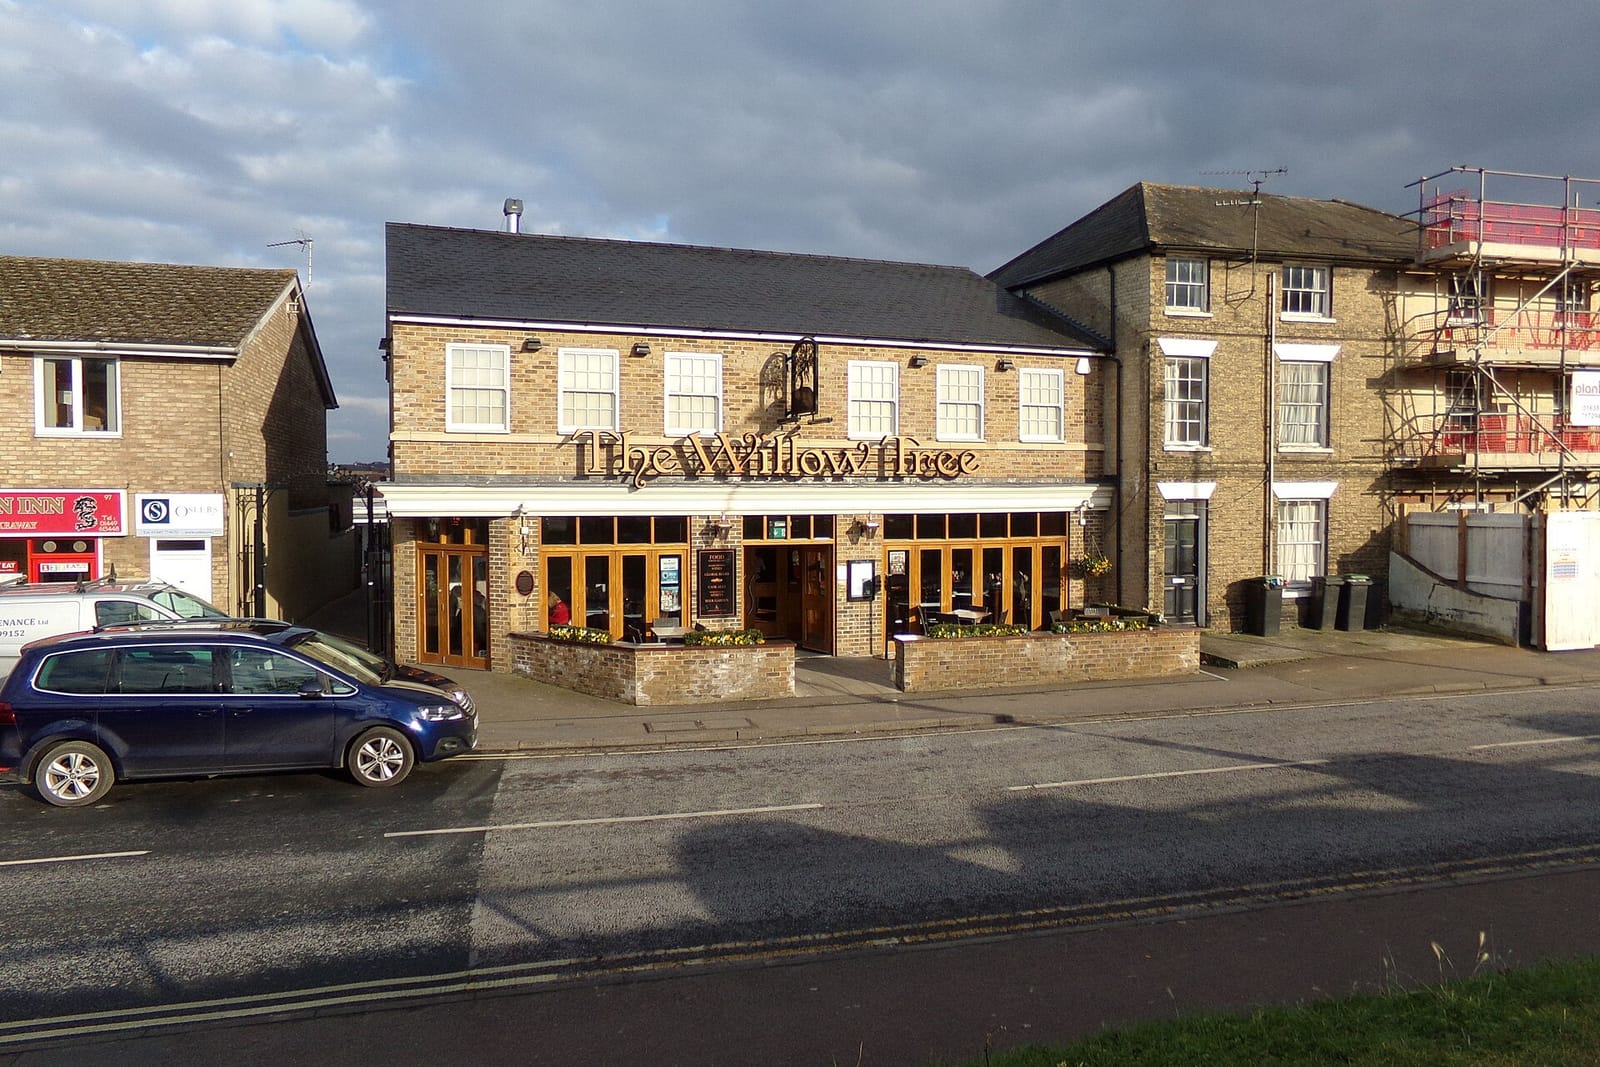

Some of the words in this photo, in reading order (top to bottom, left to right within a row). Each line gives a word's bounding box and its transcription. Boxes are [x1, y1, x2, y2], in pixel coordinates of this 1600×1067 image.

[571, 428, 677, 489] The
[687, 430, 870, 476] Willow
[880, 434, 980, 478] Tree
[17, 496, 65, 515] INN
